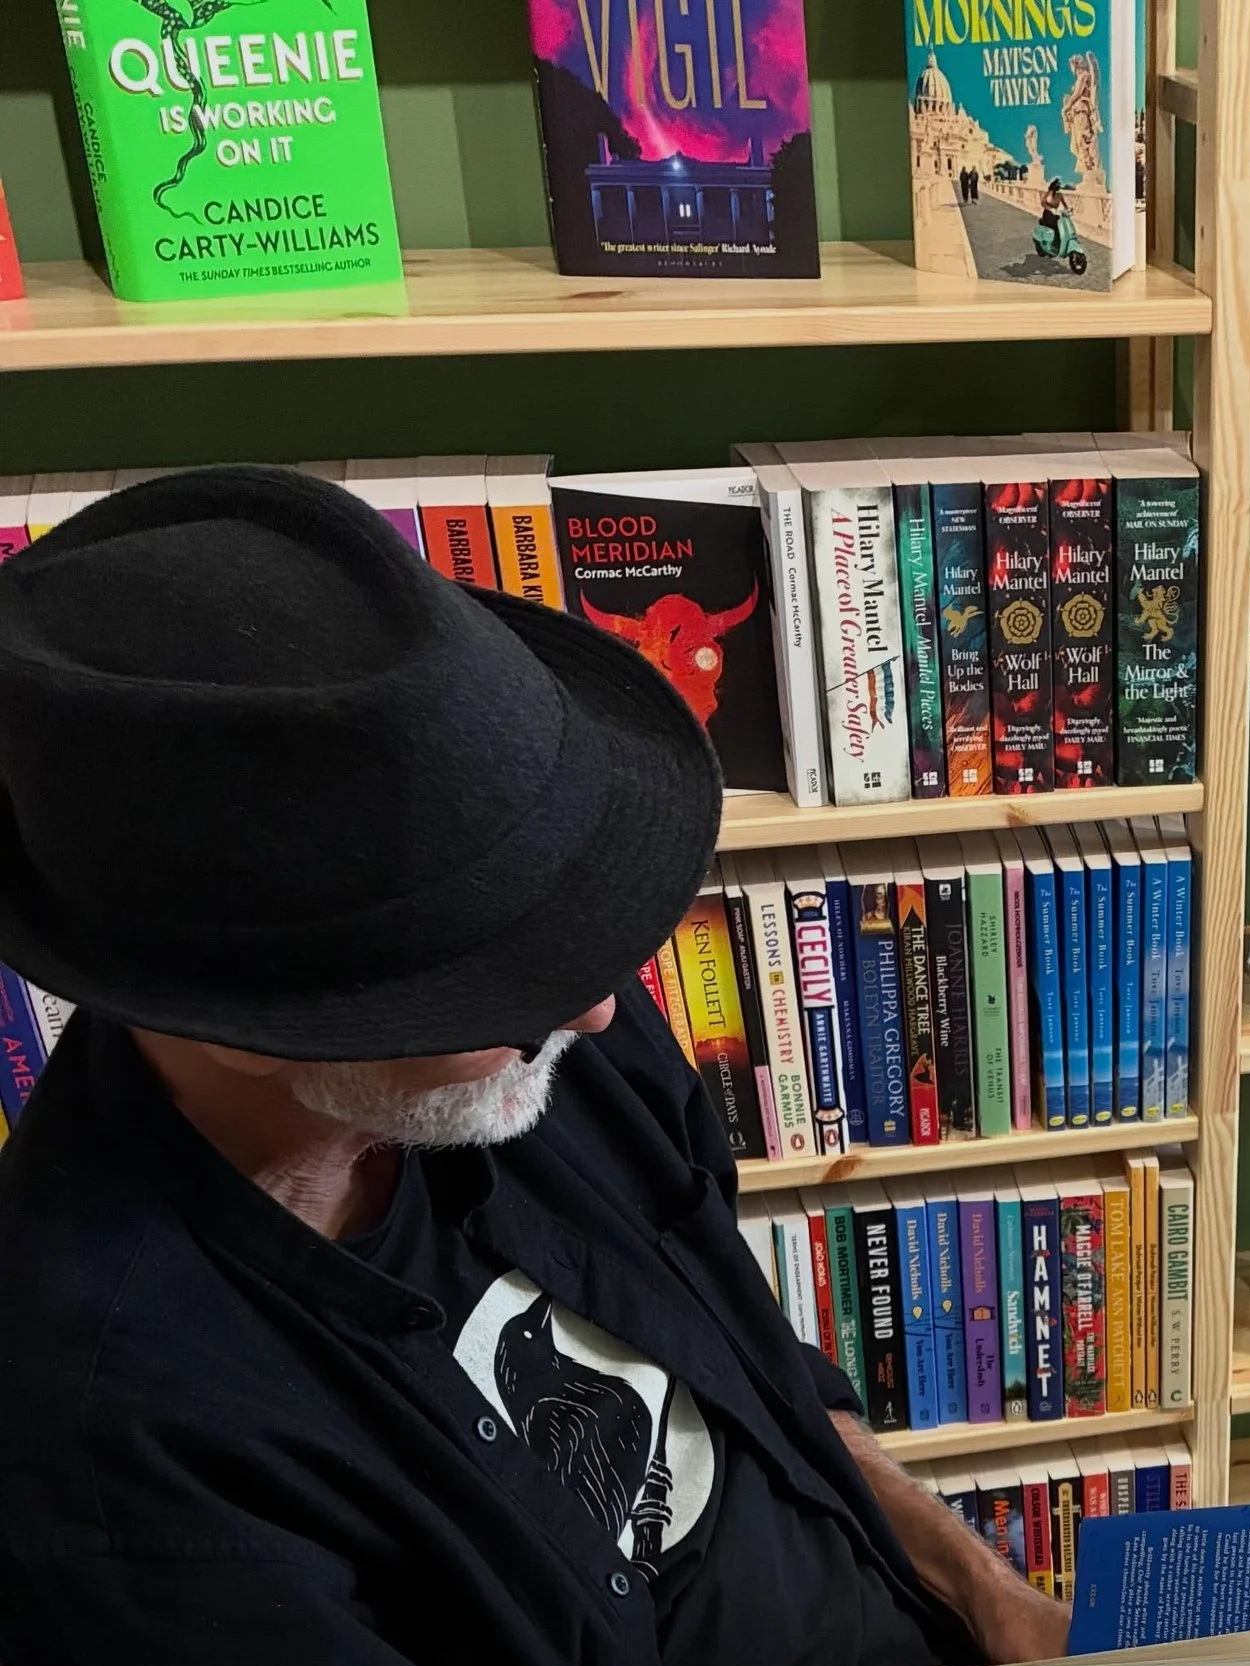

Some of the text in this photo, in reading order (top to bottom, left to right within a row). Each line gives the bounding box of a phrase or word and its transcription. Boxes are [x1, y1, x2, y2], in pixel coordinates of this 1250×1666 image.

[913, 0, 1097, 47] MORNINGS
[108, 29, 363, 97] QUEENIE
[575, 0, 768, 110] VIGIL
[982, 44, 1058, 77] MATSON
[989, 75, 1052, 108] TAYLOR
[160, 97, 336, 135] IS WORKING
[216, 137, 293, 168] ON IT
[203, 195, 327, 226] CANDICE
[154, 223, 380, 263] CARTY-WILLIAMS
[179, 258, 371, 283] THE SUNDAY TIMES BESTSELLING AUTHOR
[568, 516, 657, 540] BLOOD
[512, 515, 540, 582] BARBARA
[571, 539, 693, 565] MERIDIAN
[996, 552, 1043, 572] Hilary
[1134, 543, 1181, 564] Hilary
[575, 564, 683, 580] Cormac McCarthy
[993, 574, 1047, 591] Mantel
[1130, 564, 1184, 582] Mantel
[1004, 653, 1042, 671] Wolf
[1142, 644, 1172, 661] The
[1008, 671, 1039, 692] Hall
[1124, 665, 1190, 682] Mirror &
[1125, 683, 1189, 702] the Light
[691, 919, 726, 1029] KEN FOLLETT
[797, 924, 835, 1004] CECILY
[760, 904, 794, 1064] LESSONS CHEMISTRY
[878, 940, 905, 1117] PHILIPPA GREGORY
[906, 1219, 923, 1301] David Nicholls
[1167, 1203, 1189, 1302] CAIRO GAMBIT
[866, 1223, 894, 1340] NEVER FOUND
[1031, 1225, 1051, 1397] HAMNET
